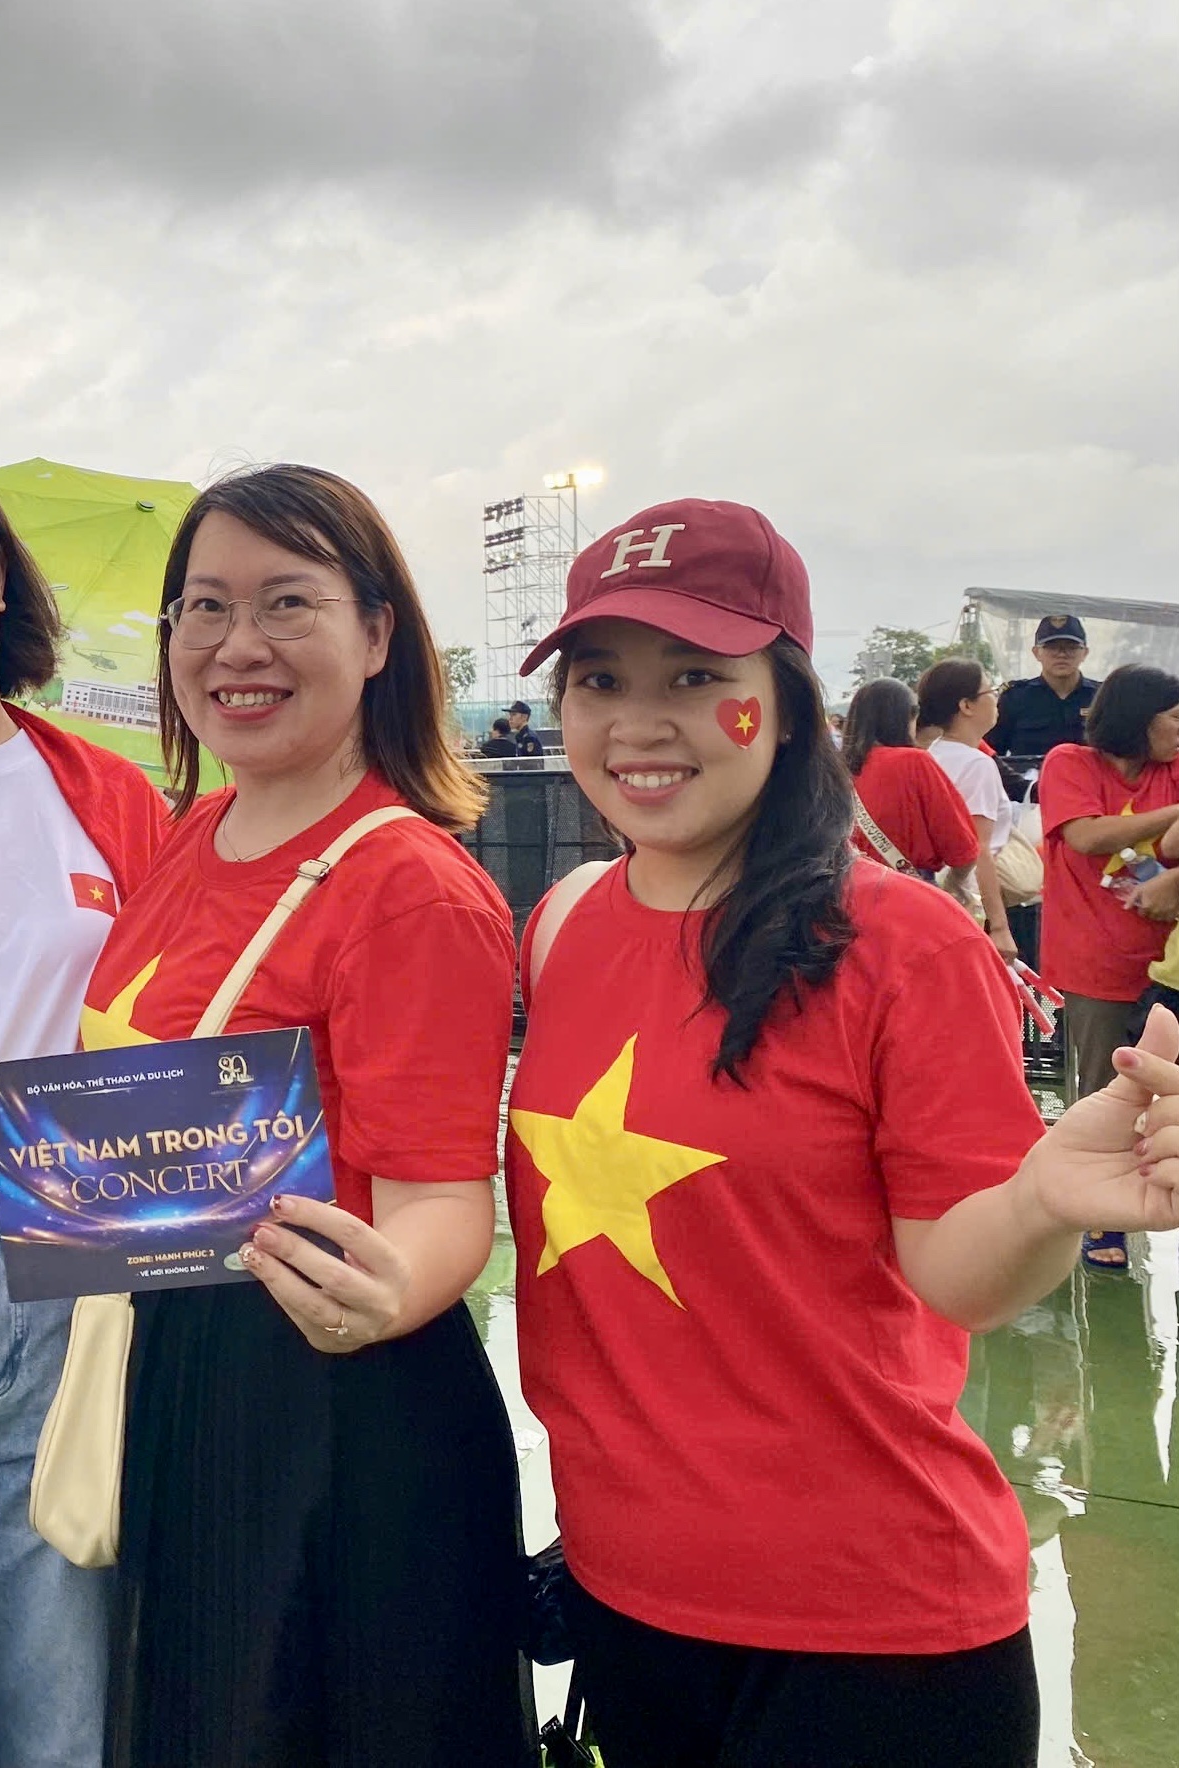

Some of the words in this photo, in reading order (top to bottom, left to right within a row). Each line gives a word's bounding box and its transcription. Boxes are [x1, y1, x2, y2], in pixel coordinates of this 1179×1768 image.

[600, 523, 686, 579] H
[26, 1084, 40, 1096] BỘ
[41, 1083, 61, 1093] VĂN
[105, 1075, 131, 1086] THAO
[132, 1071, 146, 1082] VÀ
[147, 1071, 161, 1080] DU
[162, 1069, 184, 1080] LỊCH
[9, 1138, 70, 1172] VIỆT
[75, 1134, 141, 1163] NAM
[146, 1122, 248, 1155] TRONG
[253, 1110, 304, 1143] TÔI
[71, 1158, 249, 1204] CONCERT
